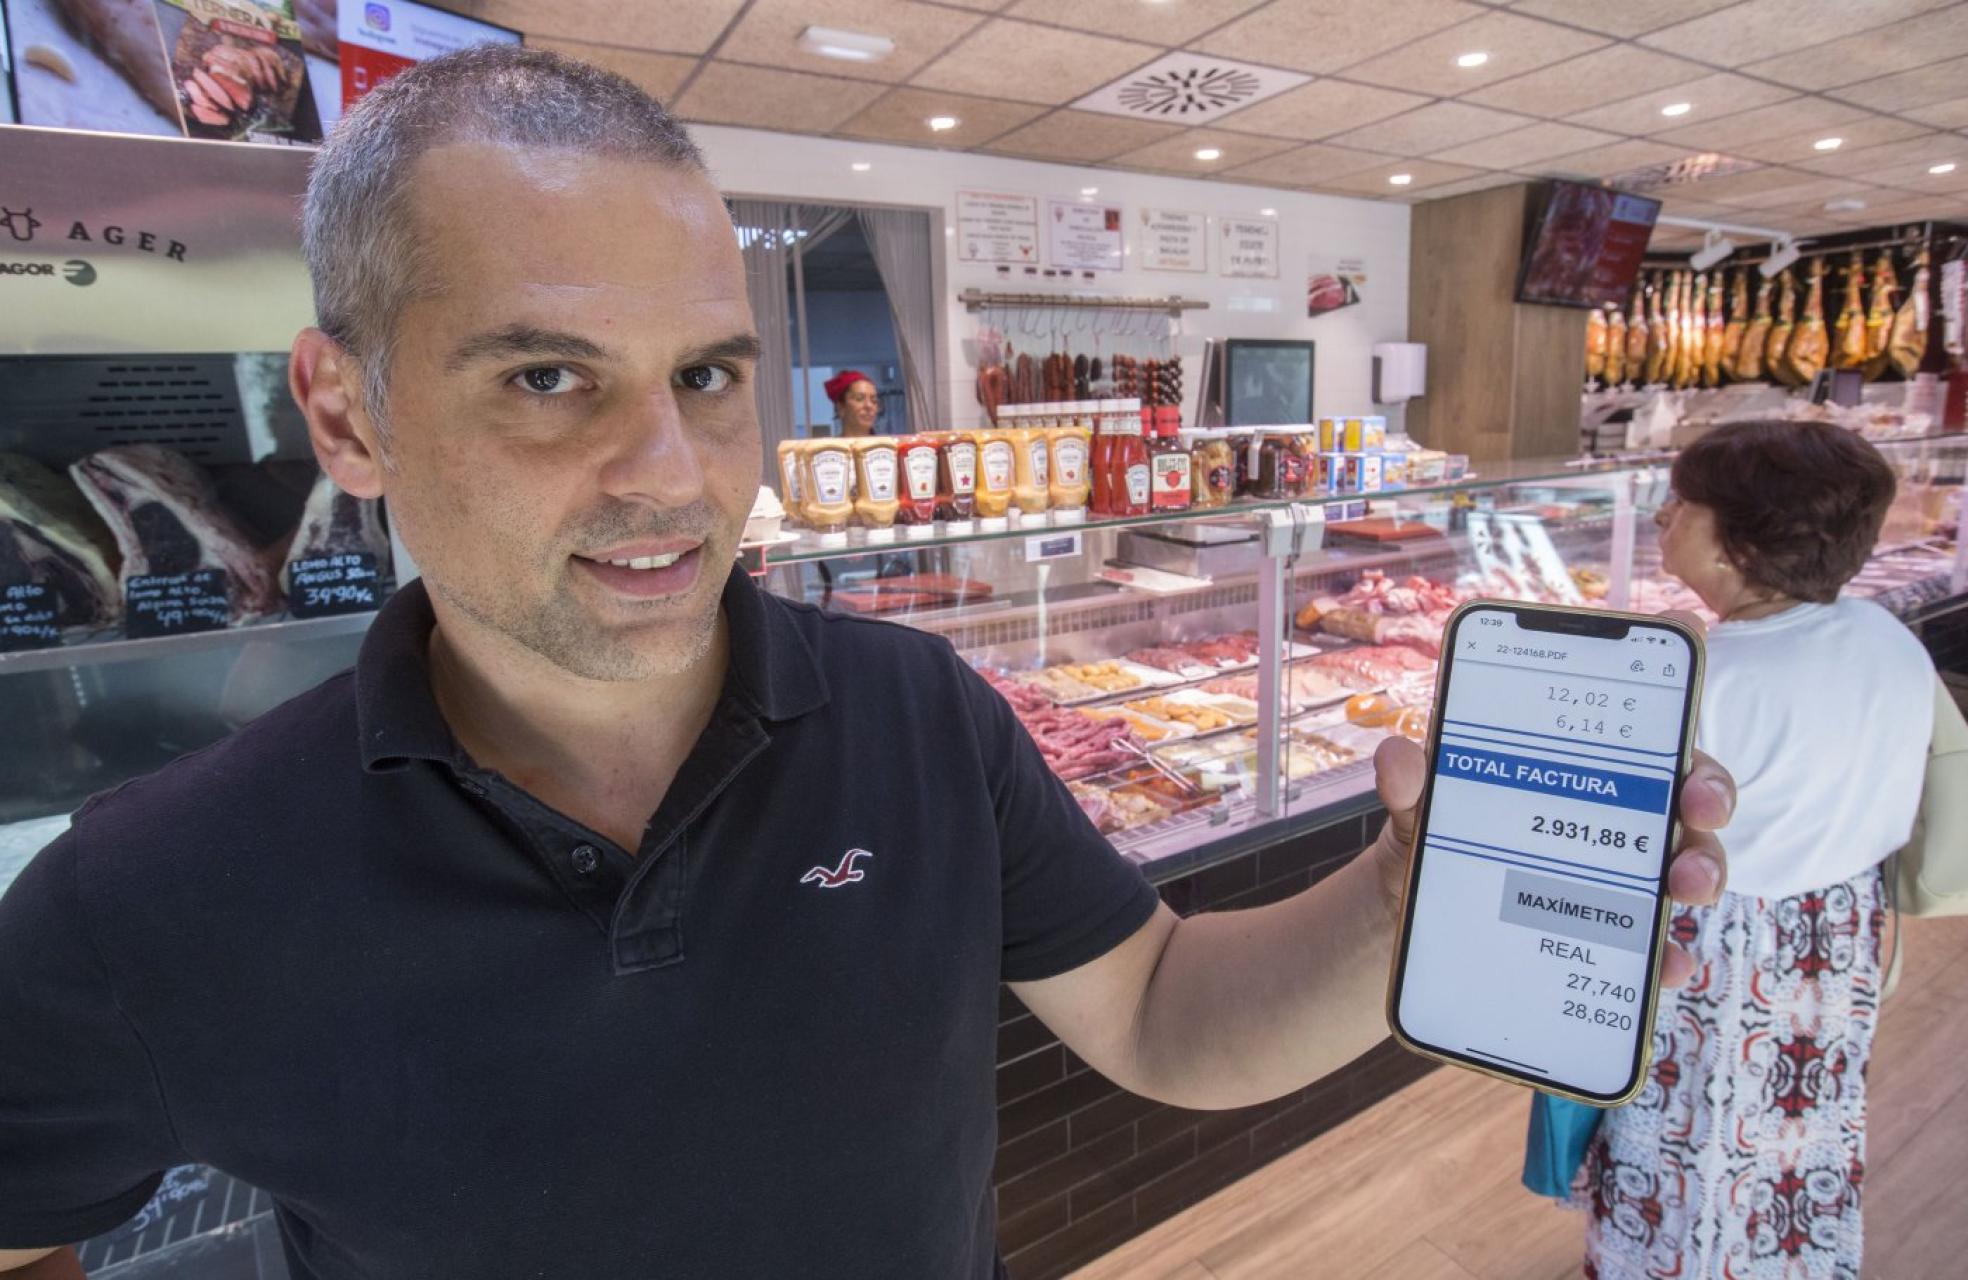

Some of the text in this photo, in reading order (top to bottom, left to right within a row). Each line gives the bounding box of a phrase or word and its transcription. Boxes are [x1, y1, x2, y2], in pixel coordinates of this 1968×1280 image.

[67, 220, 188, 263] AGER
[1479, 616, 1504, 628] 12:39
[1546, 685, 1638, 712] 12,02 €
[1555, 713, 1634, 739] 6,14 €
[1445, 751, 1619, 798] TOTAL FACTURA
[1530, 815, 1650, 855] 2.931,88 €
[1516, 890, 1635, 929] MAXÍMETRO
[1539, 937, 1597, 966] REAL
[1565, 972, 1637, 1005] 27,740
[1561, 999, 1633, 1032] 28,620
